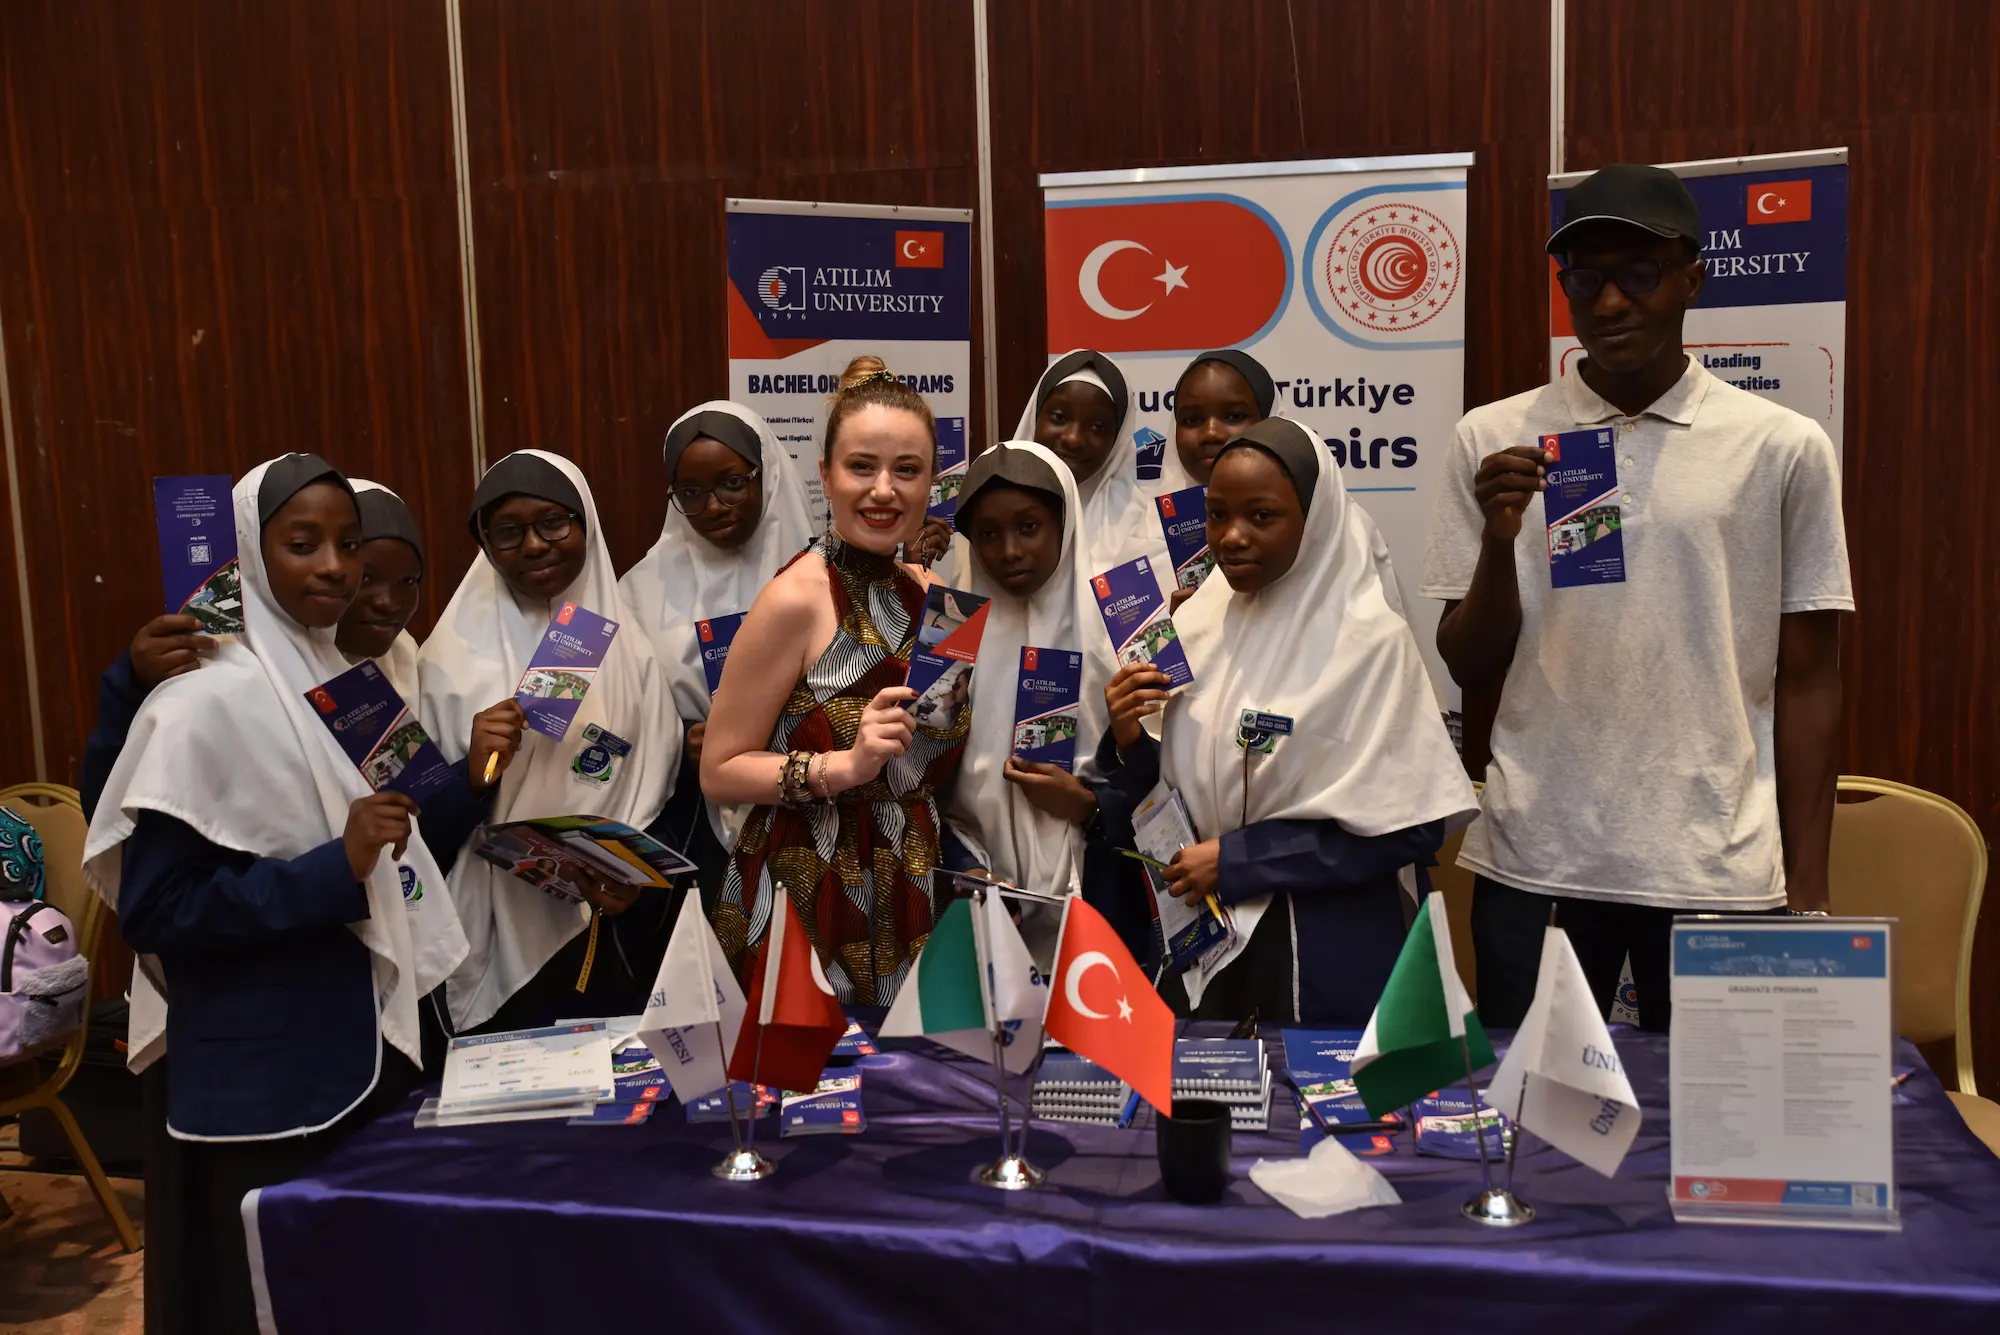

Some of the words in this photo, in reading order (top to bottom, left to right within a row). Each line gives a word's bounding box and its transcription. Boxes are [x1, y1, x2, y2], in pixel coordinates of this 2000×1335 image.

[1353, 250, 1361, 262] OF
[1429, 261, 1437, 273] OF
[1705, 251, 1811, 278] ERSITY
[813, 268, 892, 287] ATILIM
[1351, 265, 1375, 304] REPUBLIC
[1412, 276, 1435, 302] TRADE
[813, 293, 944, 313] UNIVERSITY
[1703, 353, 1761, 370] Leading
[748, 374, 841, 394] BACHELOR
[1322, 427, 1418, 469] airs
[1562, 468, 1587, 477] ATILIM
[1562, 473, 1604, 484] UNIVERSITY
[1180, 518, 1200, 528] ATILIM
[1116, 594, 1136, 607] ATILIM
[1117, 594, 1150, 612] UNIVERSITY
[562, 634, 583, 646] ATILIM
[560, 639, 593, 657] UNIVERSITY
[1035, 685, 1068, 693] UNIVERSITY
[1257, 720, 1273, 728] HEAD
[1728, 985, 1770, 994] GRADUATE
